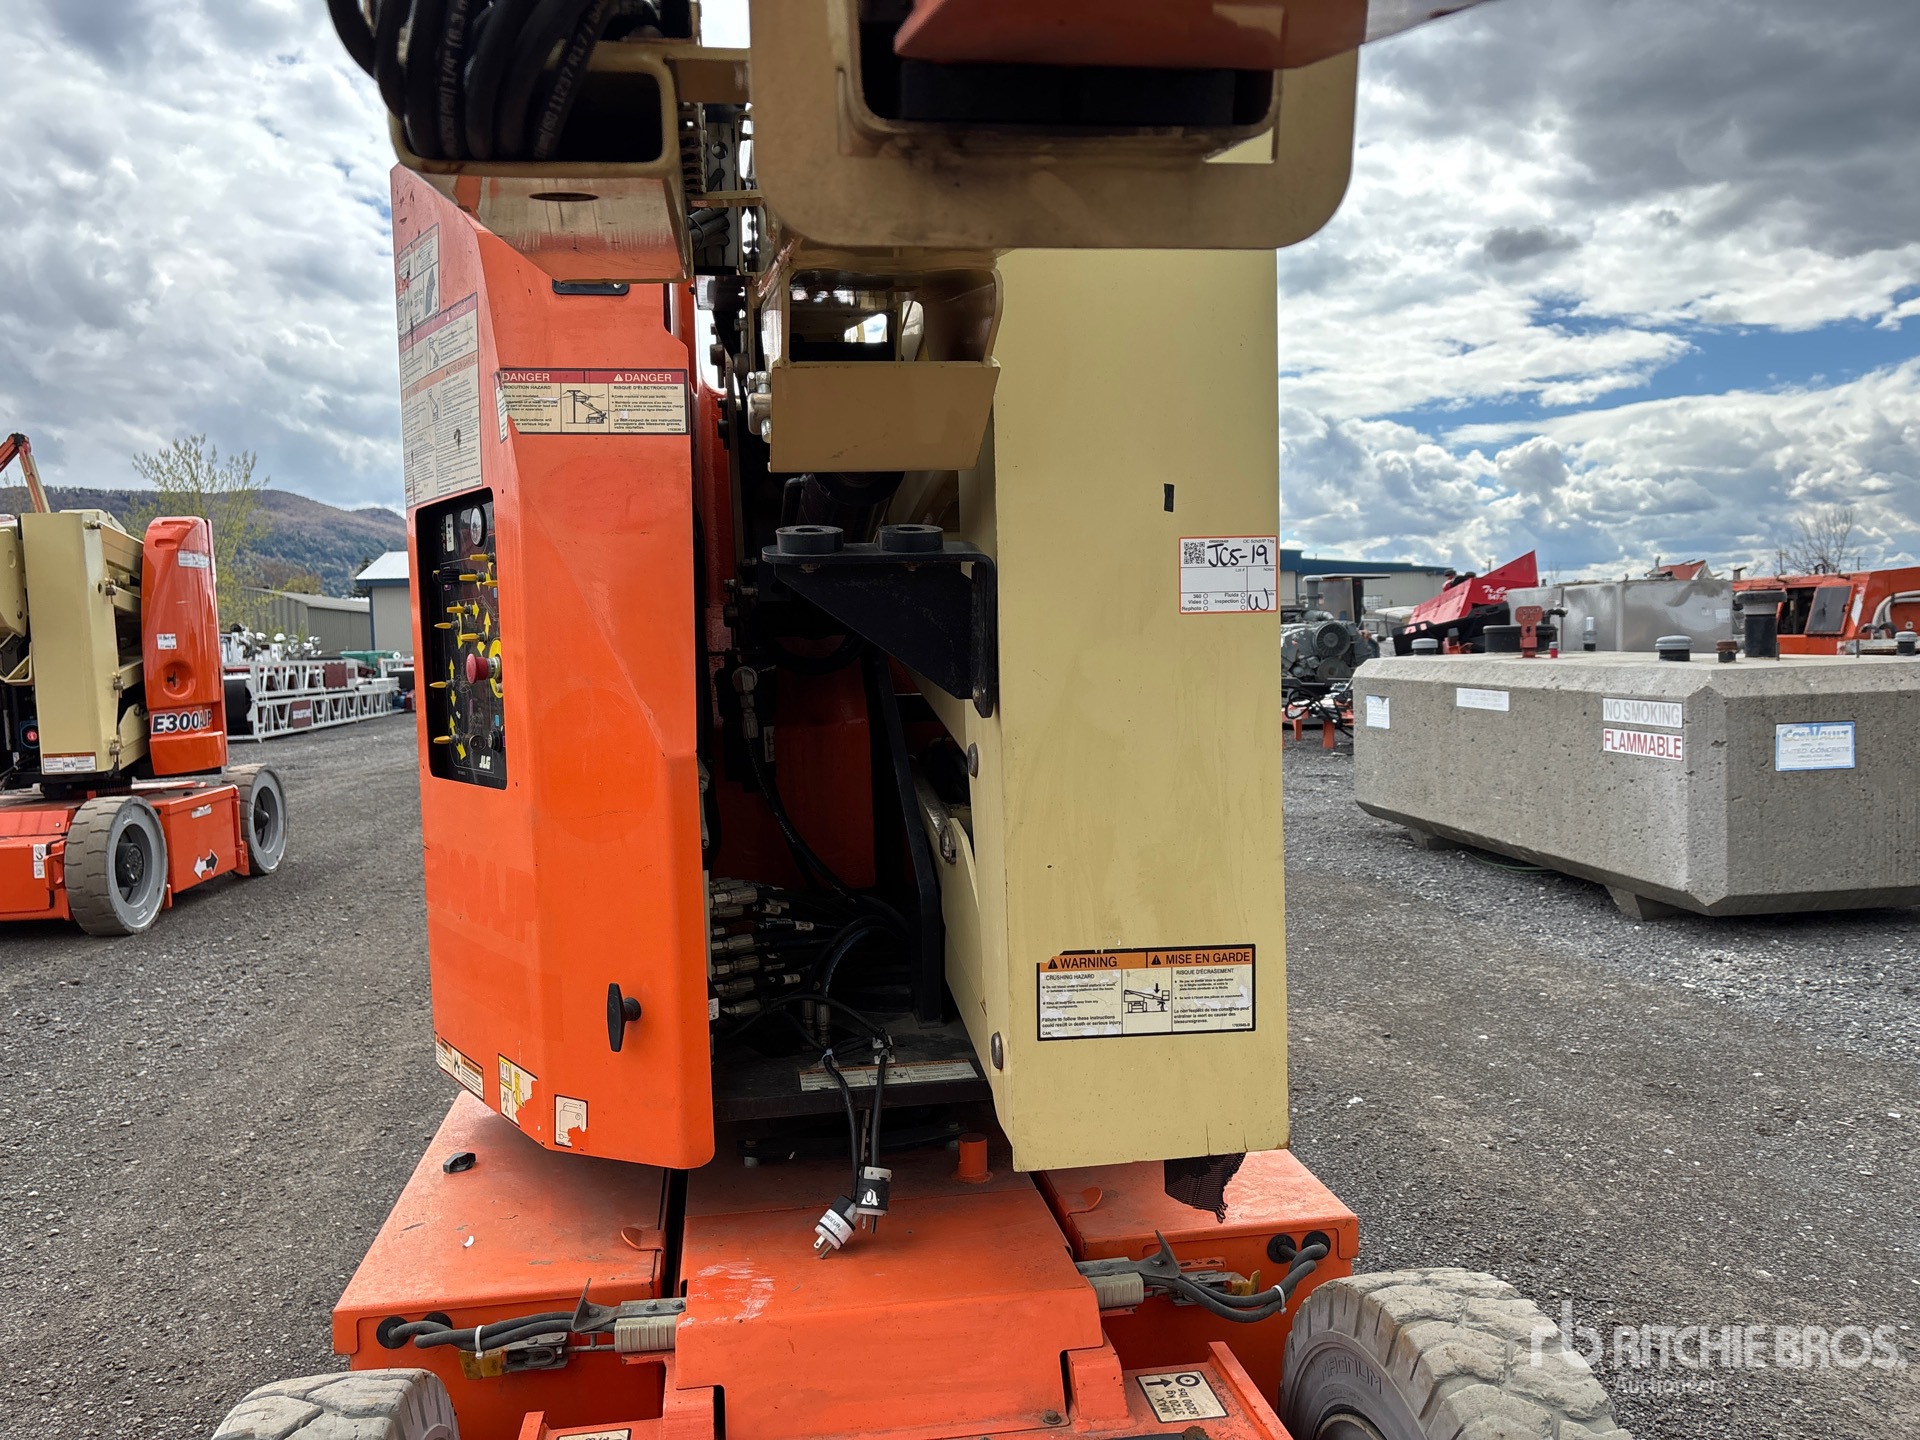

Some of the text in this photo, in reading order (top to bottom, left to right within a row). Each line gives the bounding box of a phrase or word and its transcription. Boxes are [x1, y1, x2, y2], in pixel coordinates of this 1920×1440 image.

[502, 372, 550, 382] DANGER
[624, 373, 672, 382] DANGER
[1605, 701, 1680, 725] NO SMOKING
[151, 709, 213, 735] E300AJP
[1604, 730, 1681, 758] FLAMMABLE
[479, 755, 491, 770] JLG
[1060, 956, 1117, 969] WARNING
[1166, 952, 1250, 965] MISE EN GARDE
[1155, 1397, 1172, 1413] MAX
[1166, 1390, 1185, 1416] 3720 kg
[1178, 1388, 1199, 1415] 8200 lbs
